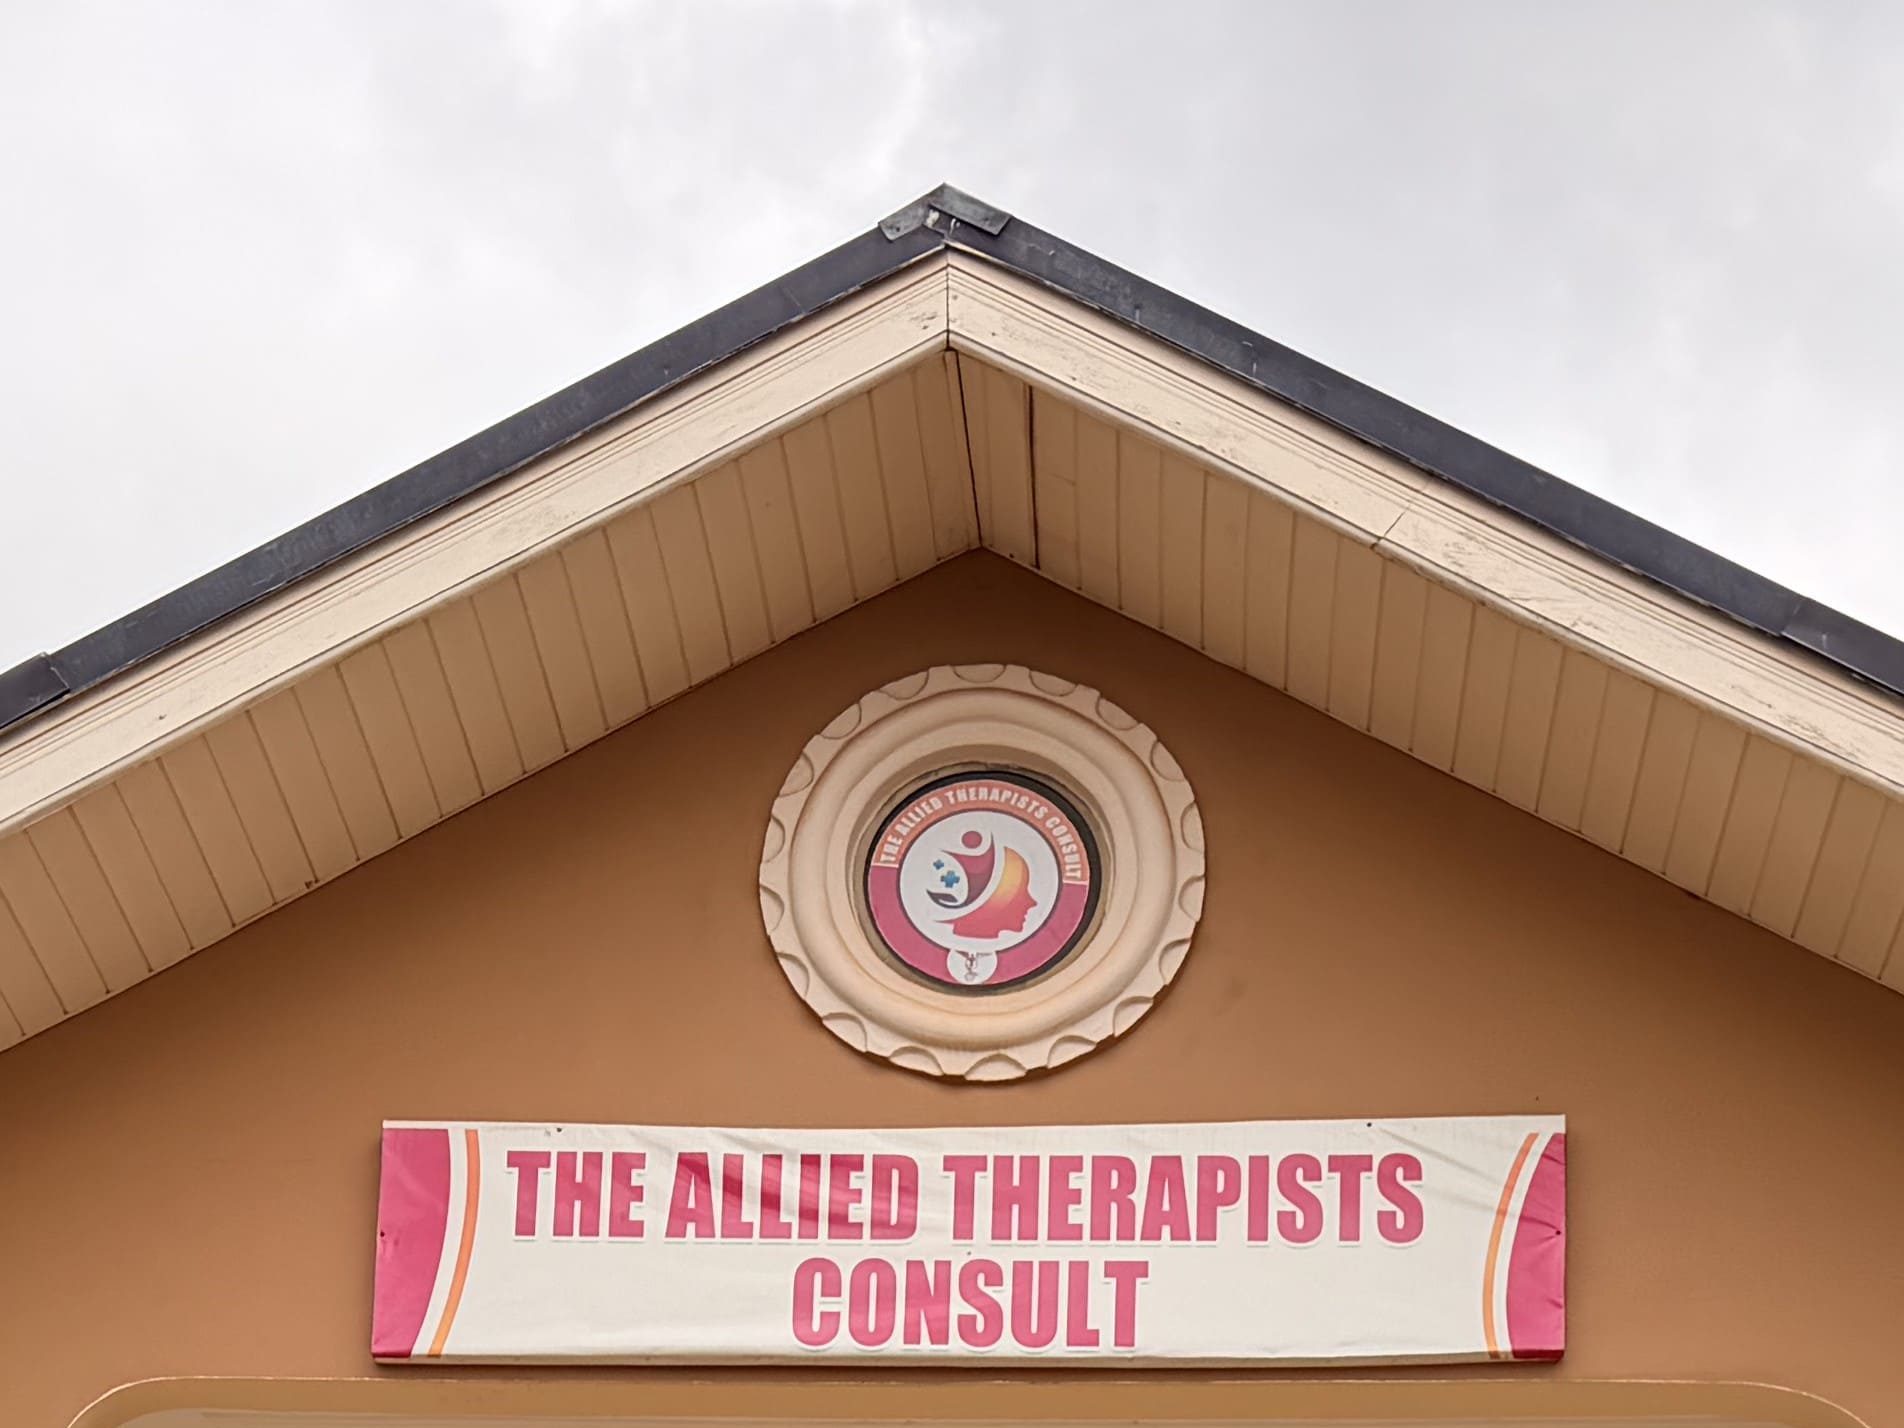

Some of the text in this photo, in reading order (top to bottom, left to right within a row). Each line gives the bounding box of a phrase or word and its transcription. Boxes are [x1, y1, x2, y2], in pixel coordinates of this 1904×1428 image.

[880, 787, 1082, 880] THE ALLIED THERAPISTS CONSULT
[506, 1150, 1425, 1245] THE ALLIED THERAPISTS
[791, 1257, 1150, 1350] CONSULT
